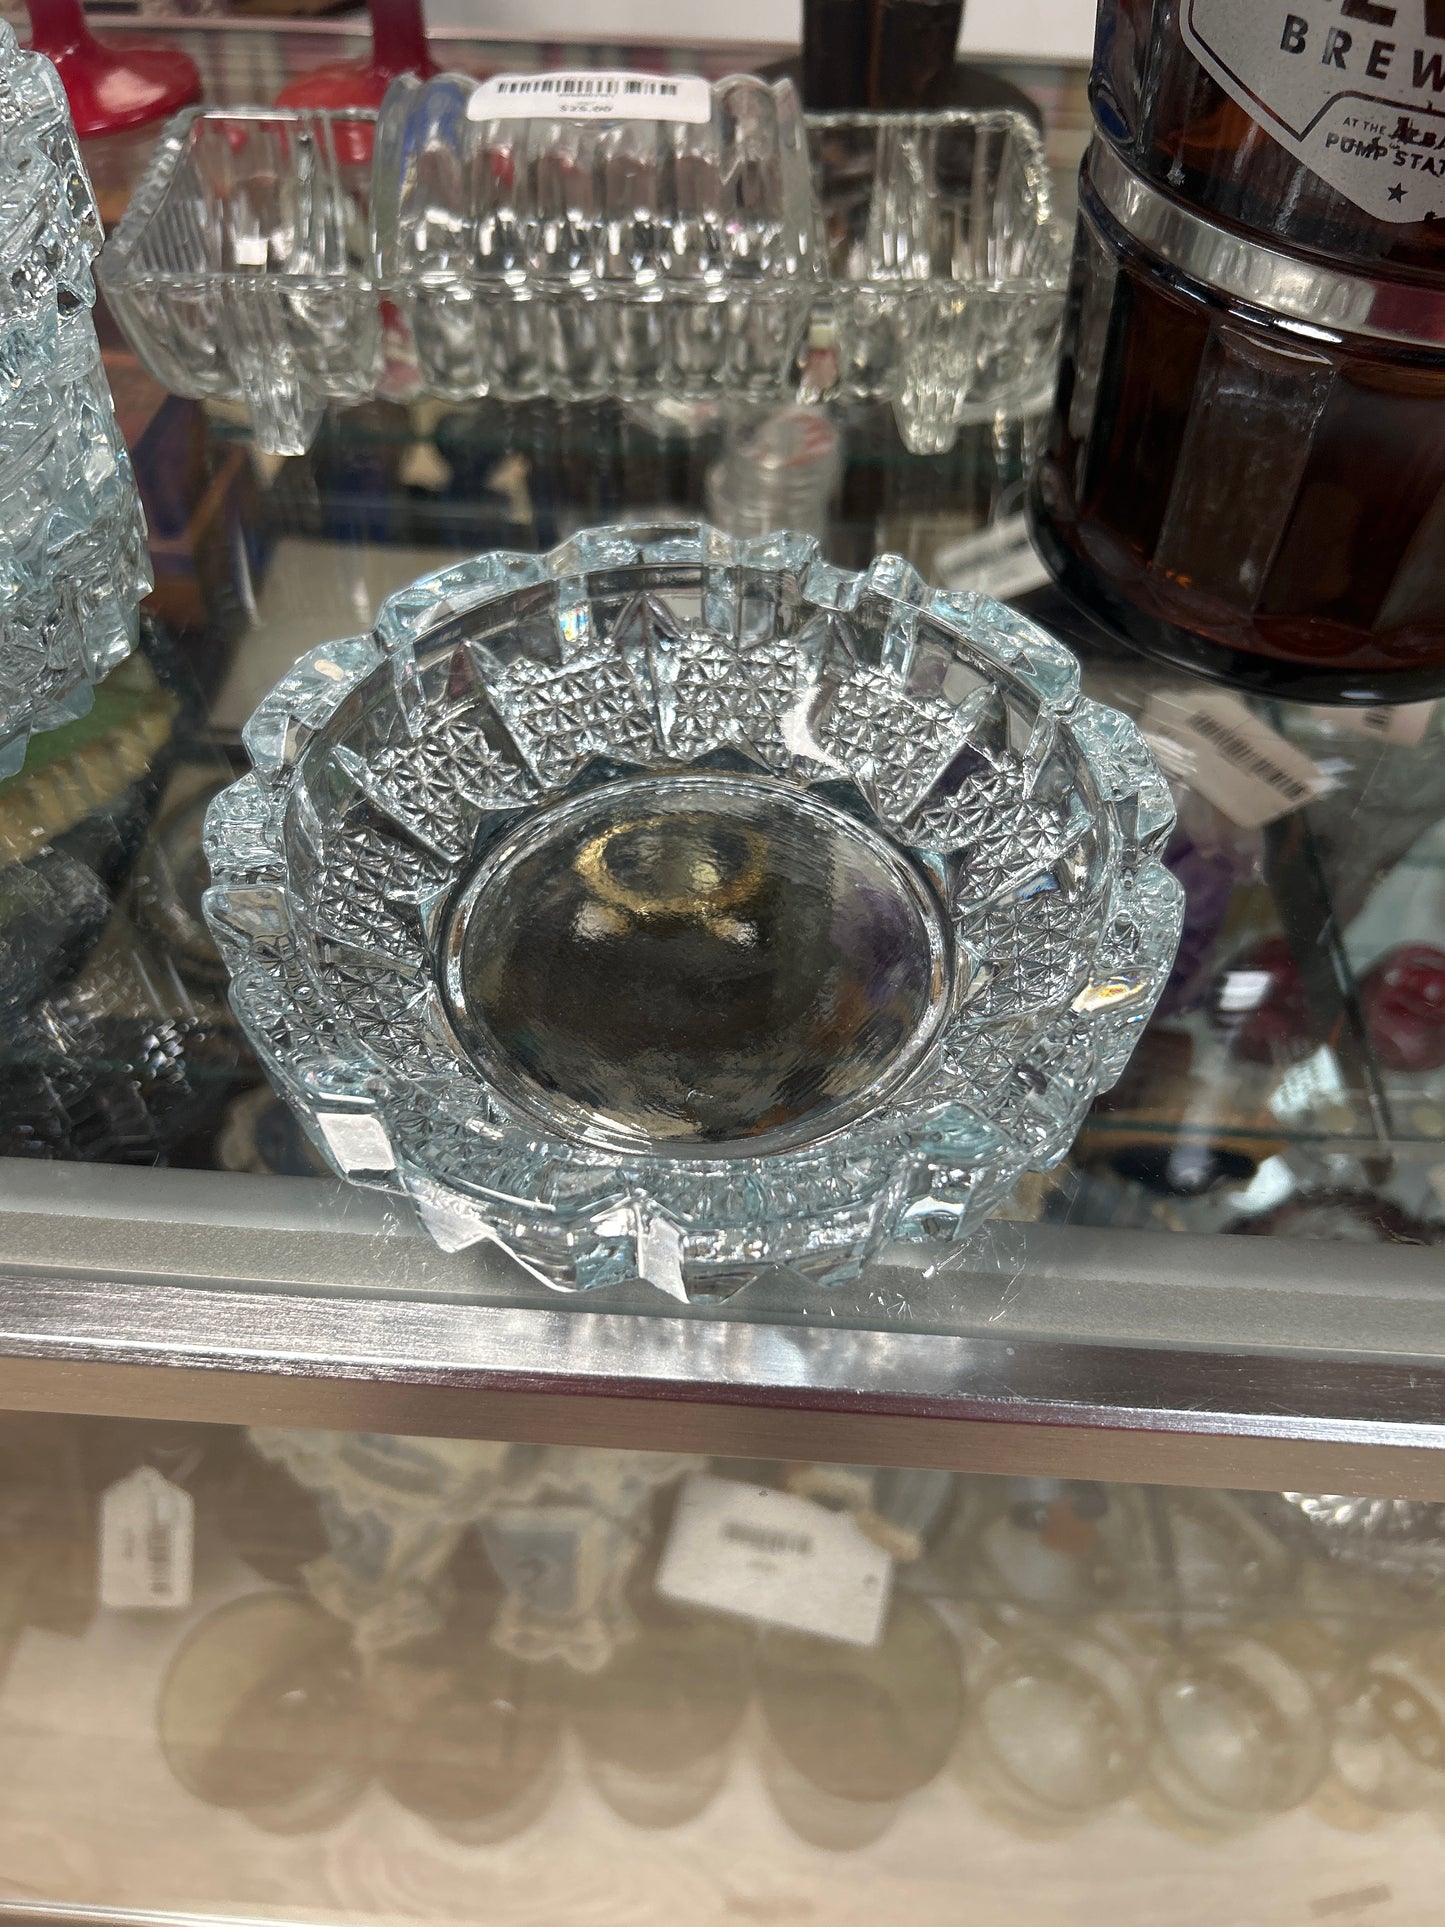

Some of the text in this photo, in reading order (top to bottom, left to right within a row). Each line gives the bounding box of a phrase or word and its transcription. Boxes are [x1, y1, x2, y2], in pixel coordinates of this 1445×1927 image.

[1342, 117, 1358, 128] AT
[1363, 121, 1387, 135] THE
[1325, 132, 1388, 161] PUMP
